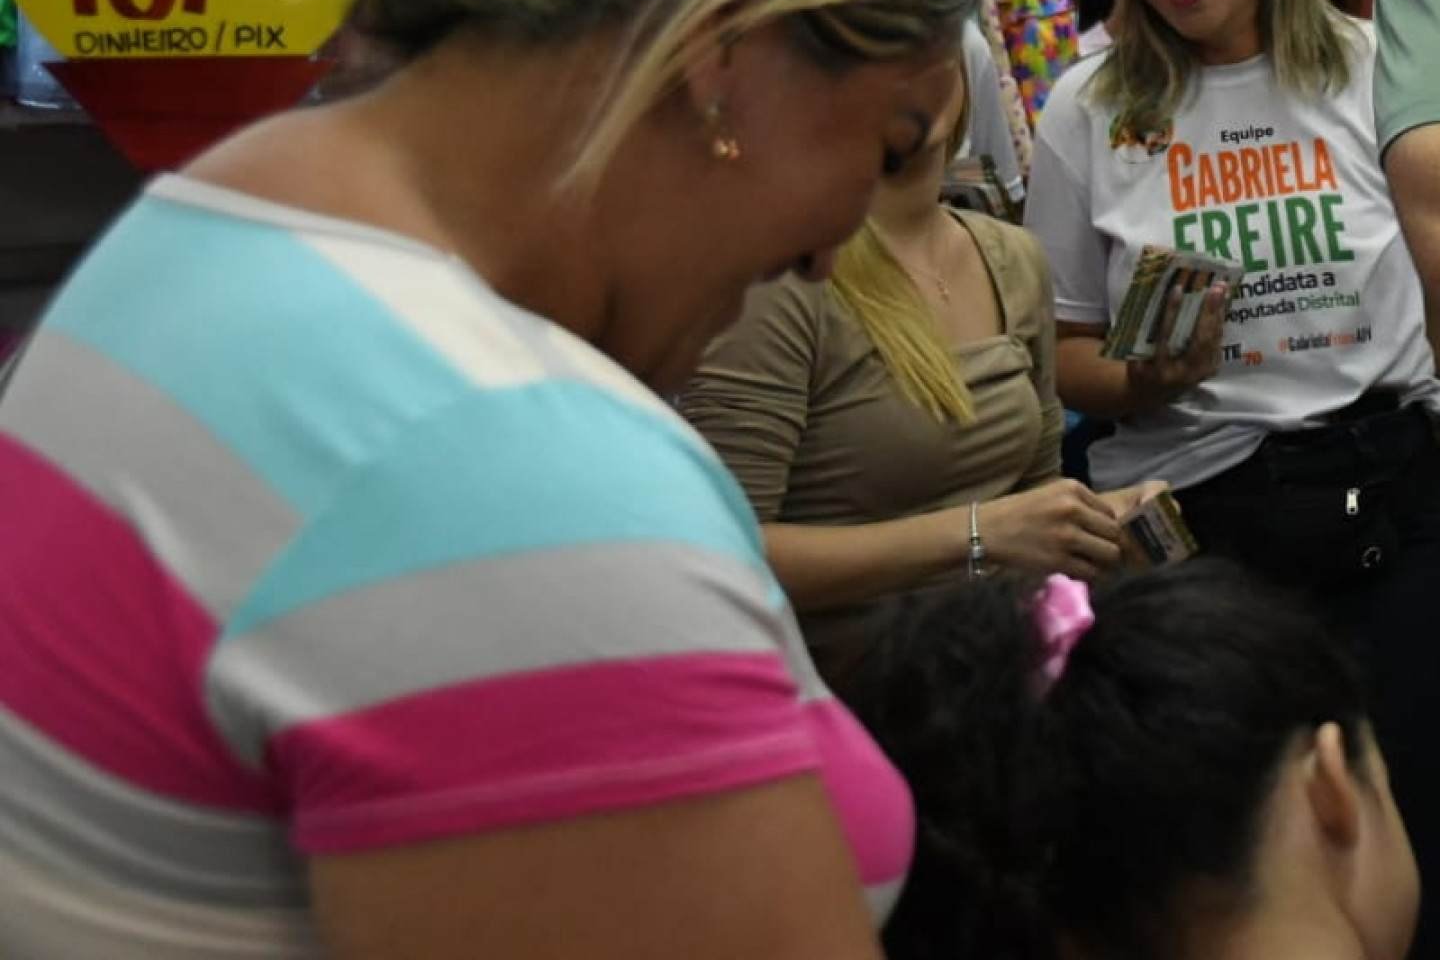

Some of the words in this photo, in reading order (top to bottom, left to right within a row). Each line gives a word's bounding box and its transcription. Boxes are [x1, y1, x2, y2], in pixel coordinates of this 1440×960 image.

[74, 28, 207, 54] DINHEIRO
[234, 24, 287, 50] PIX
[1220, 125, 1275, 144] Equipe
[1173, 194, 1355, 273] FREIRE
[1322, 272, 1336, 288] a
[1225, 298, 1296, 324] eputada
[1297, 291, 1361, 311] Distrital
